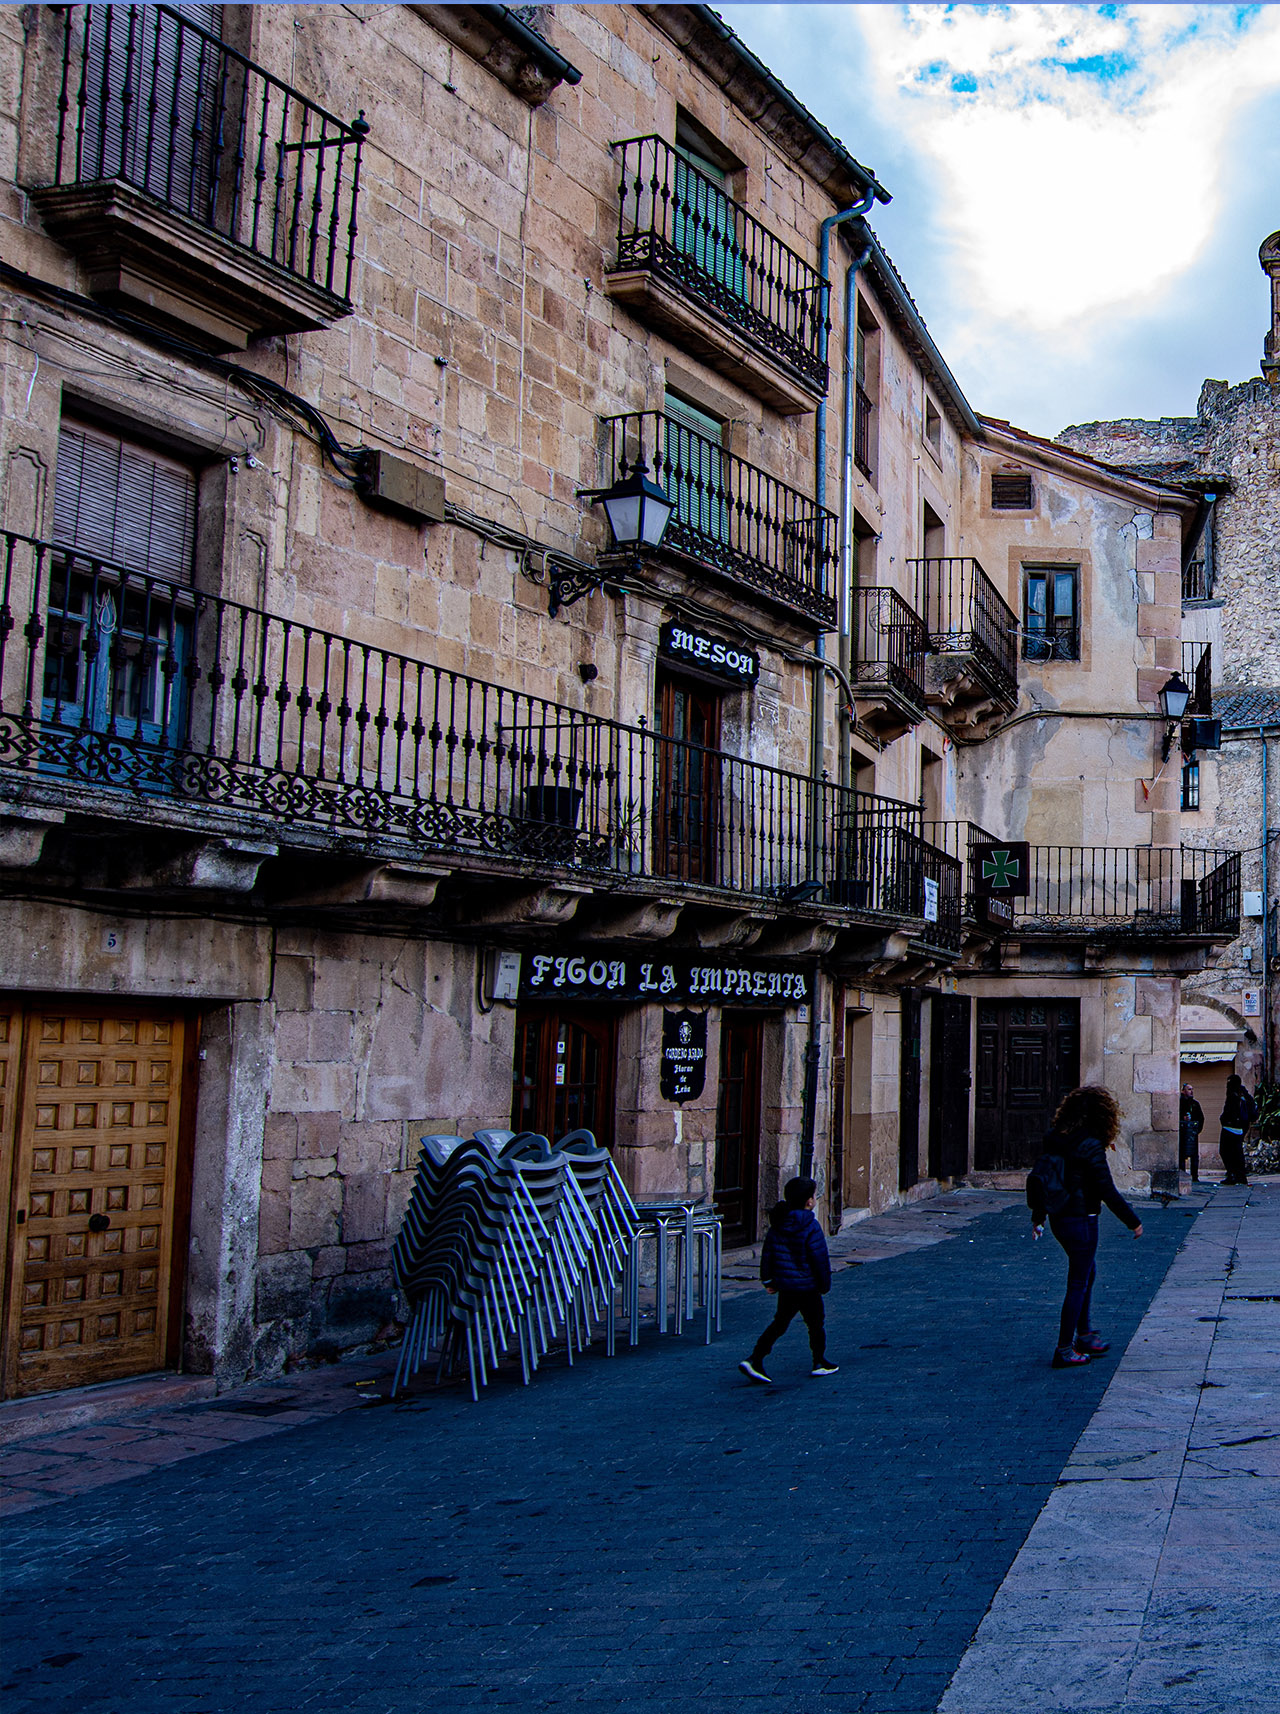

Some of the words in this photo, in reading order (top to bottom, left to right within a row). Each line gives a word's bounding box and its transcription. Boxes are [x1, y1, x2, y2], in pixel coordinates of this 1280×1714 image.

[670, 628, 753, 674] MESON
[108, 933, 117, 948] 5
[530, 955, 626, 989] FIGON
[639, 963, 678, 994] LA
[689, 967, 807, 999] IMPRENTA
